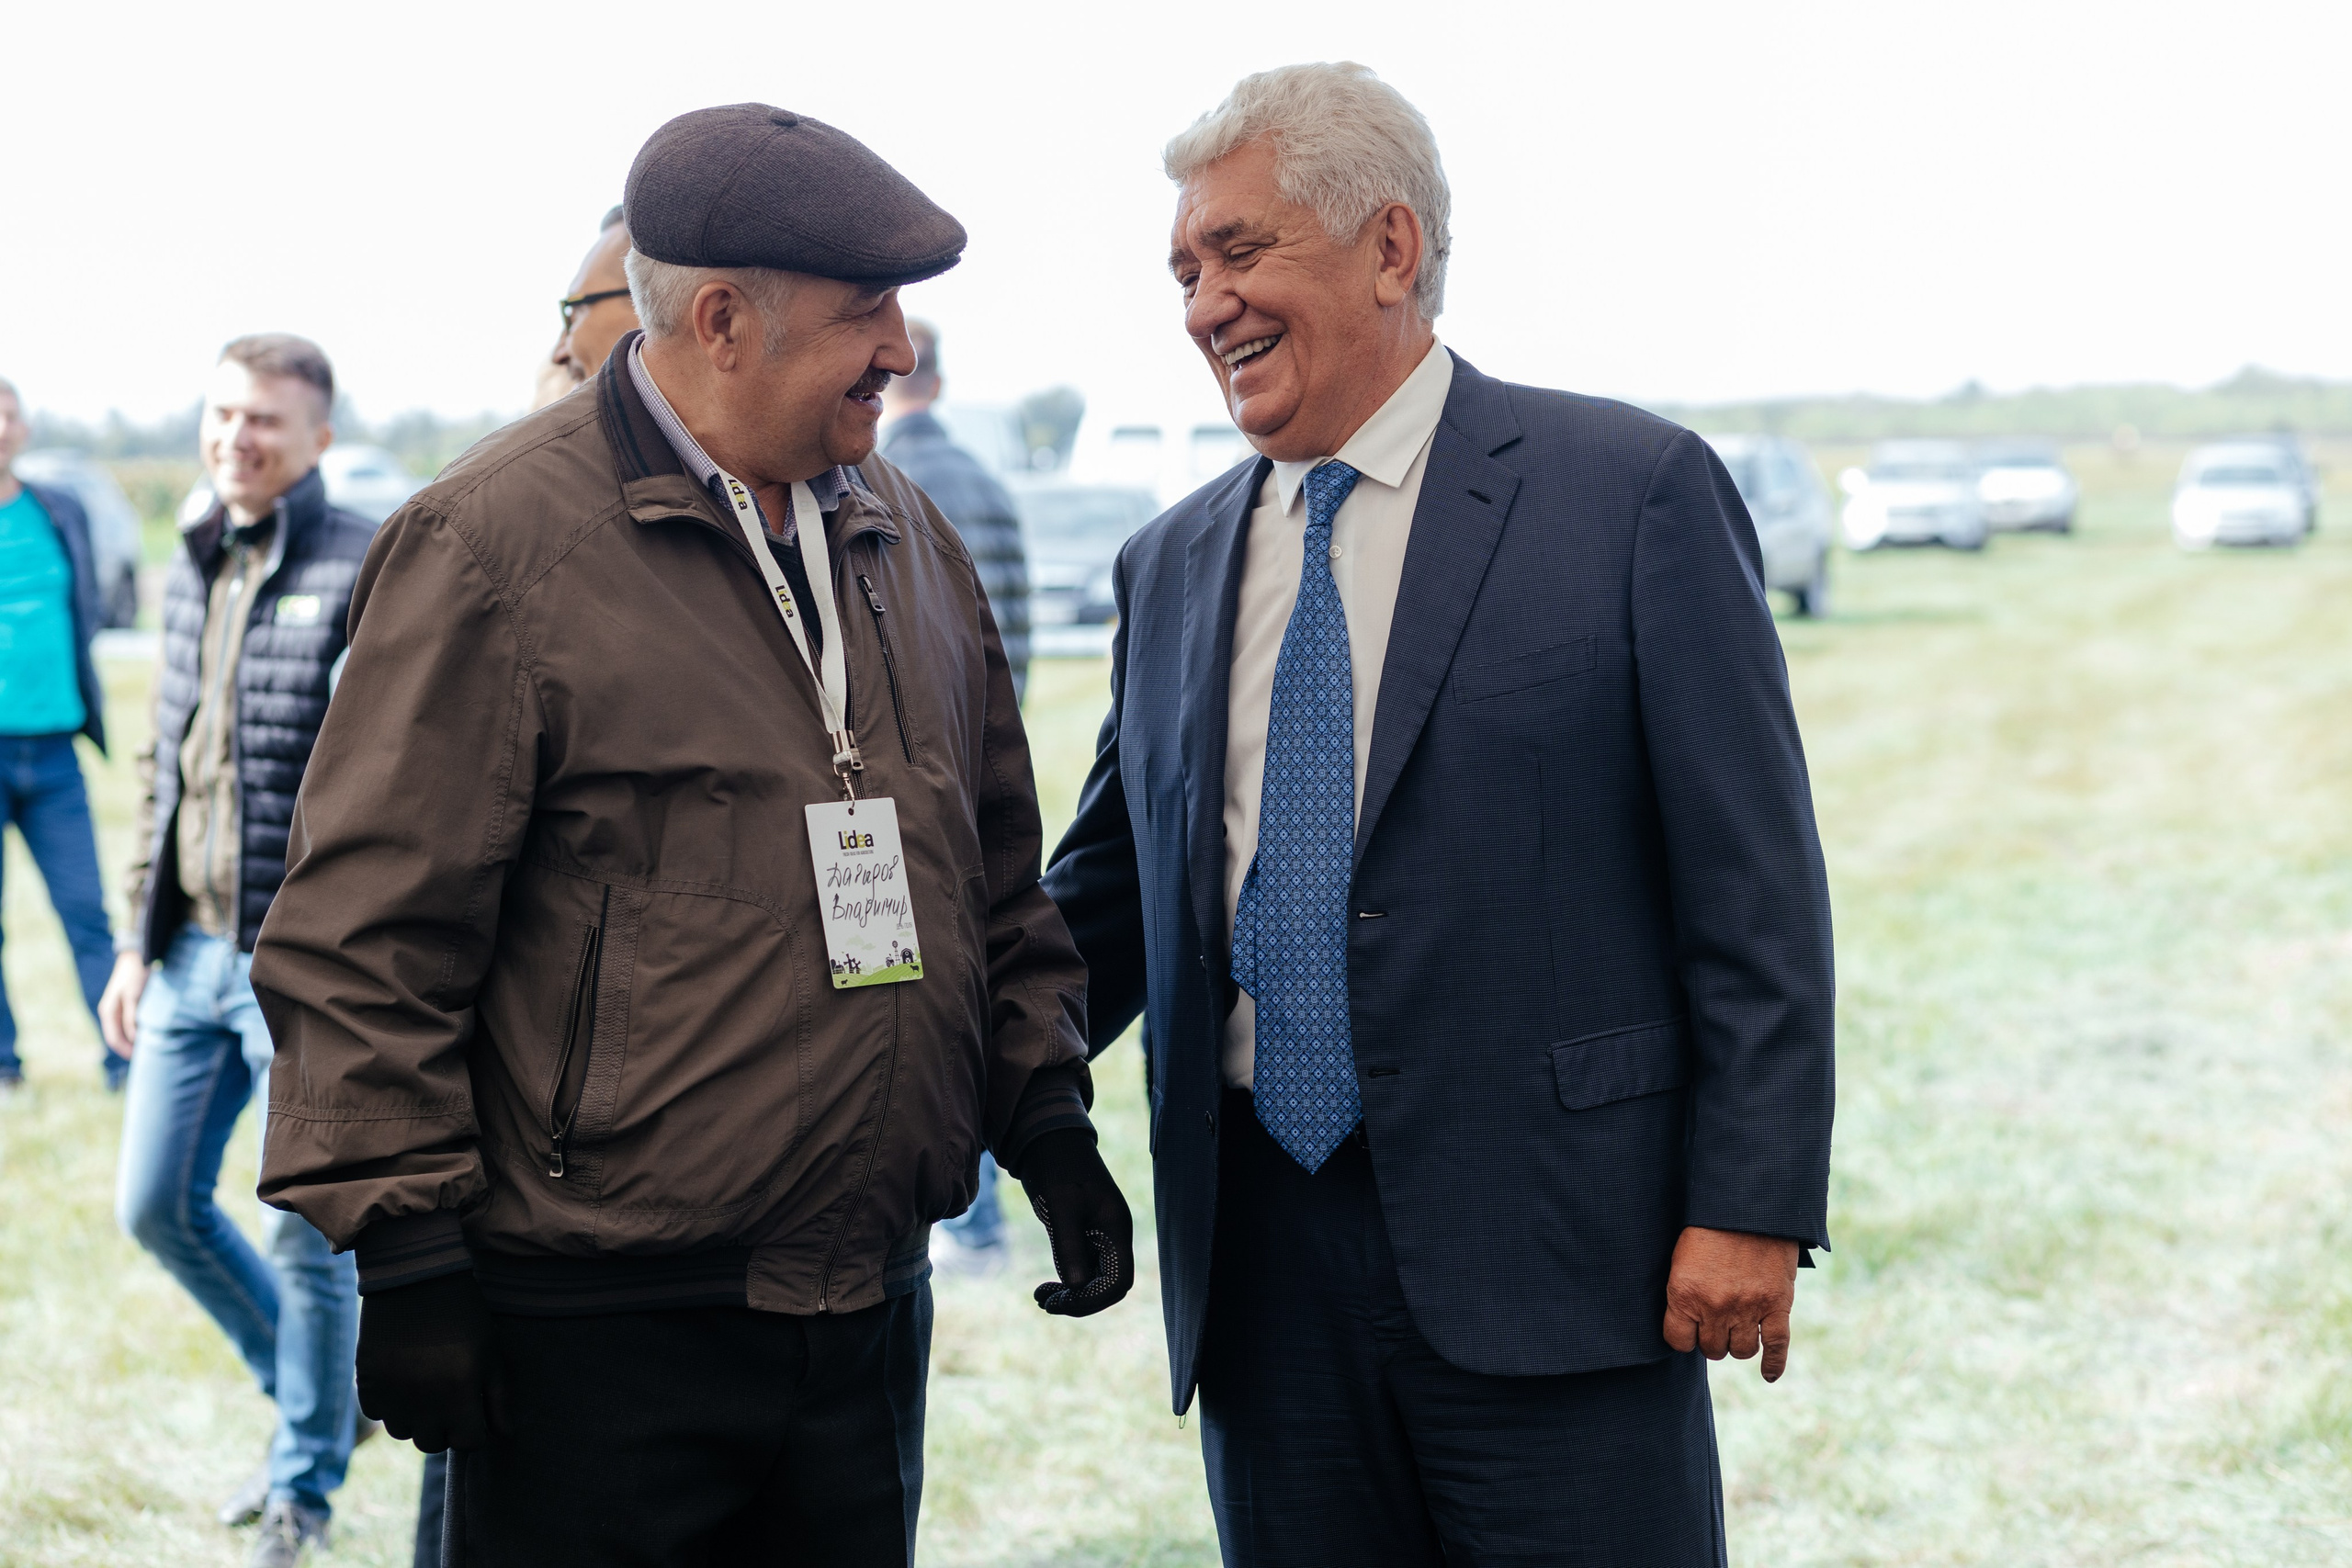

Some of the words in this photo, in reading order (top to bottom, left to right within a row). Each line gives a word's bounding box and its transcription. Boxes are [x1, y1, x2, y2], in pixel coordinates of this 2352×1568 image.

[728, 479, 748, 511] Lidea
[775, 584, 794, 618] Lidea
[838, 829, 874, 851] Lidea
[831, 892, 908, 929] Владимир
